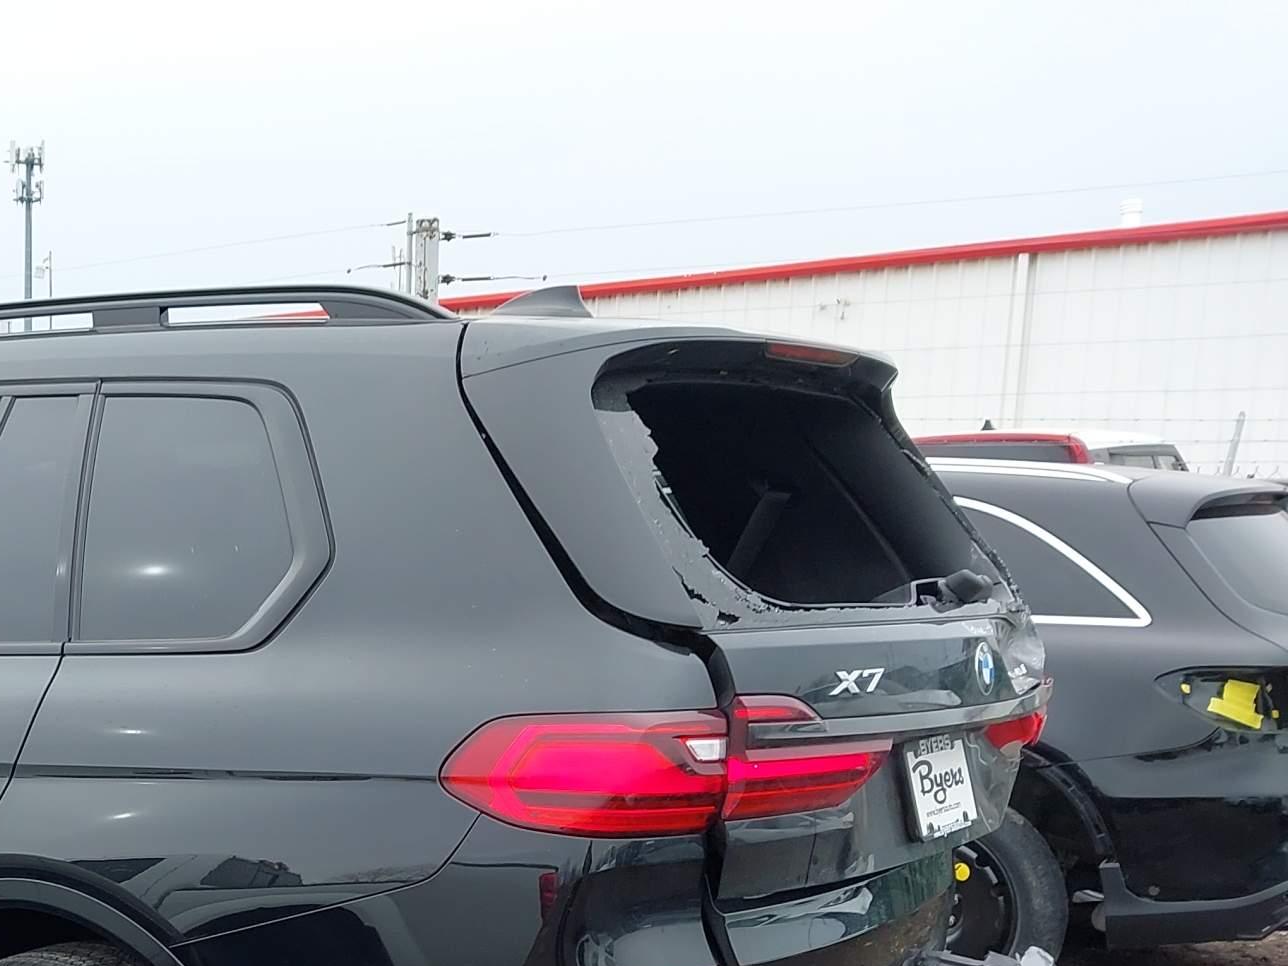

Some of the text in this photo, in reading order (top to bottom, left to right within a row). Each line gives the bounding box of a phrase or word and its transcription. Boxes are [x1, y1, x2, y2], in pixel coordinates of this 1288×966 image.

[828, 667, 886, 697] X7
[918, 734, 952, 755] BYERS
[912, 759, 964, 805] Byers
